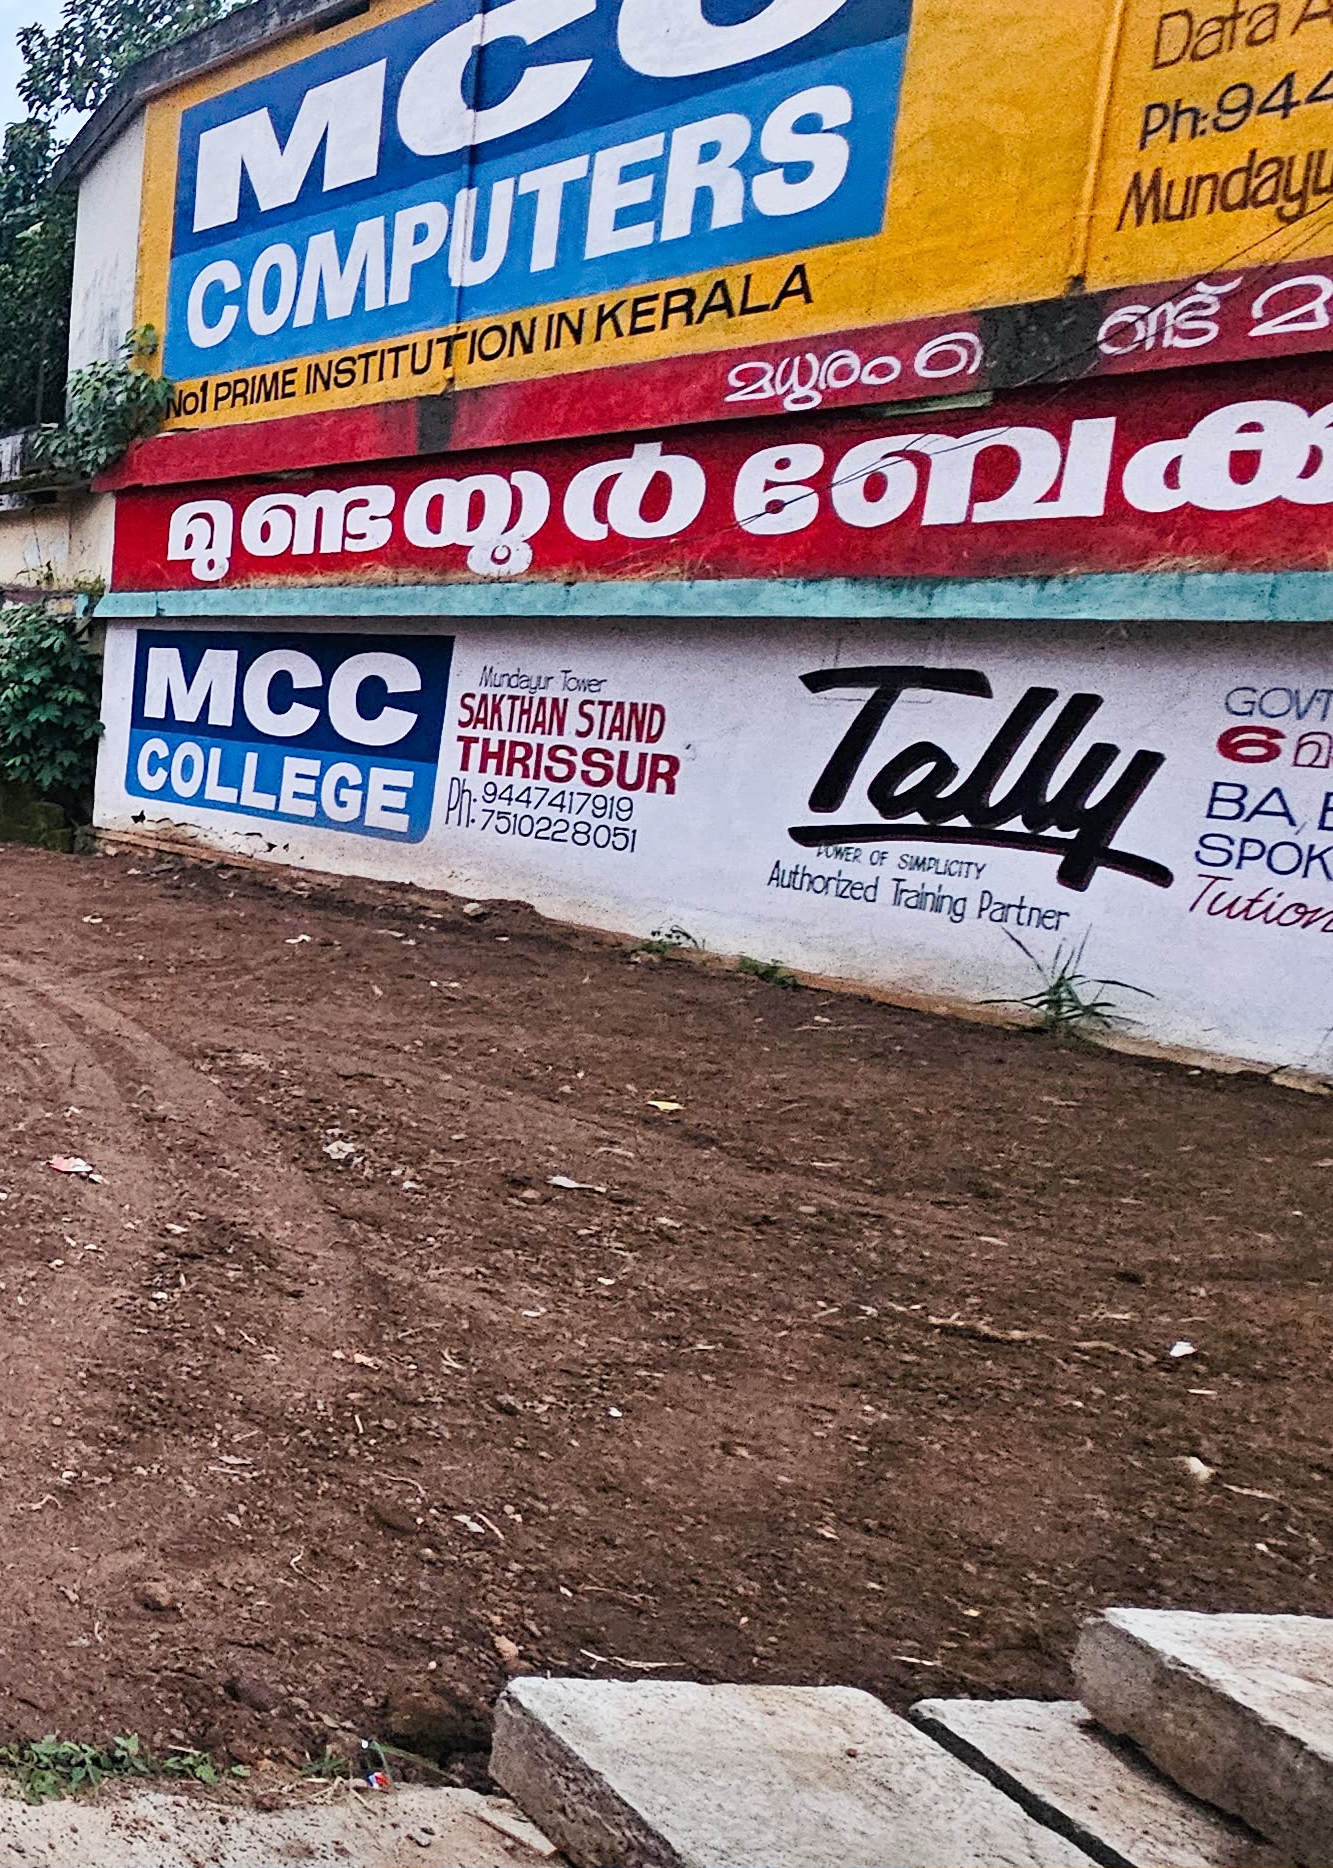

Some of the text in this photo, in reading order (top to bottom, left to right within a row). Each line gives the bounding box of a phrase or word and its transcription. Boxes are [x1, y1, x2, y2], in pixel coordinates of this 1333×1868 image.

[1151, 0, 1281, 70] Data
[186, 85, 853, 348] COMPUTERS
[213, 366, 299, 411] PRIME
[305, 316, 537, 396] INSTITUTION
[544, 307, 587, 351] IN
[594, 263, 814, 342] KERALA
[143, 647, 422, 746] MCC
[478, 665, 608, 694] Mundayur Tower
[457, 692, 666, 744] SAKTHAN STAND
[1216, 725, 1287, 764] 6
[137, 736, 415, 833] COLLEGE
[456, 735, 681, 795] THRISSUR
[799, 665, 1165, 891] Tally
[480, 808, 638, 853] 7510228051
[481, 781, 634, 822] 9447417919
[869, 848, 890, 866] OF
[897, 853, 986, 880] SIMPLICITY
[1194, 832, 1333, 881] SPOK
[767, 859, 1071, 932] Authorized Training Partner
